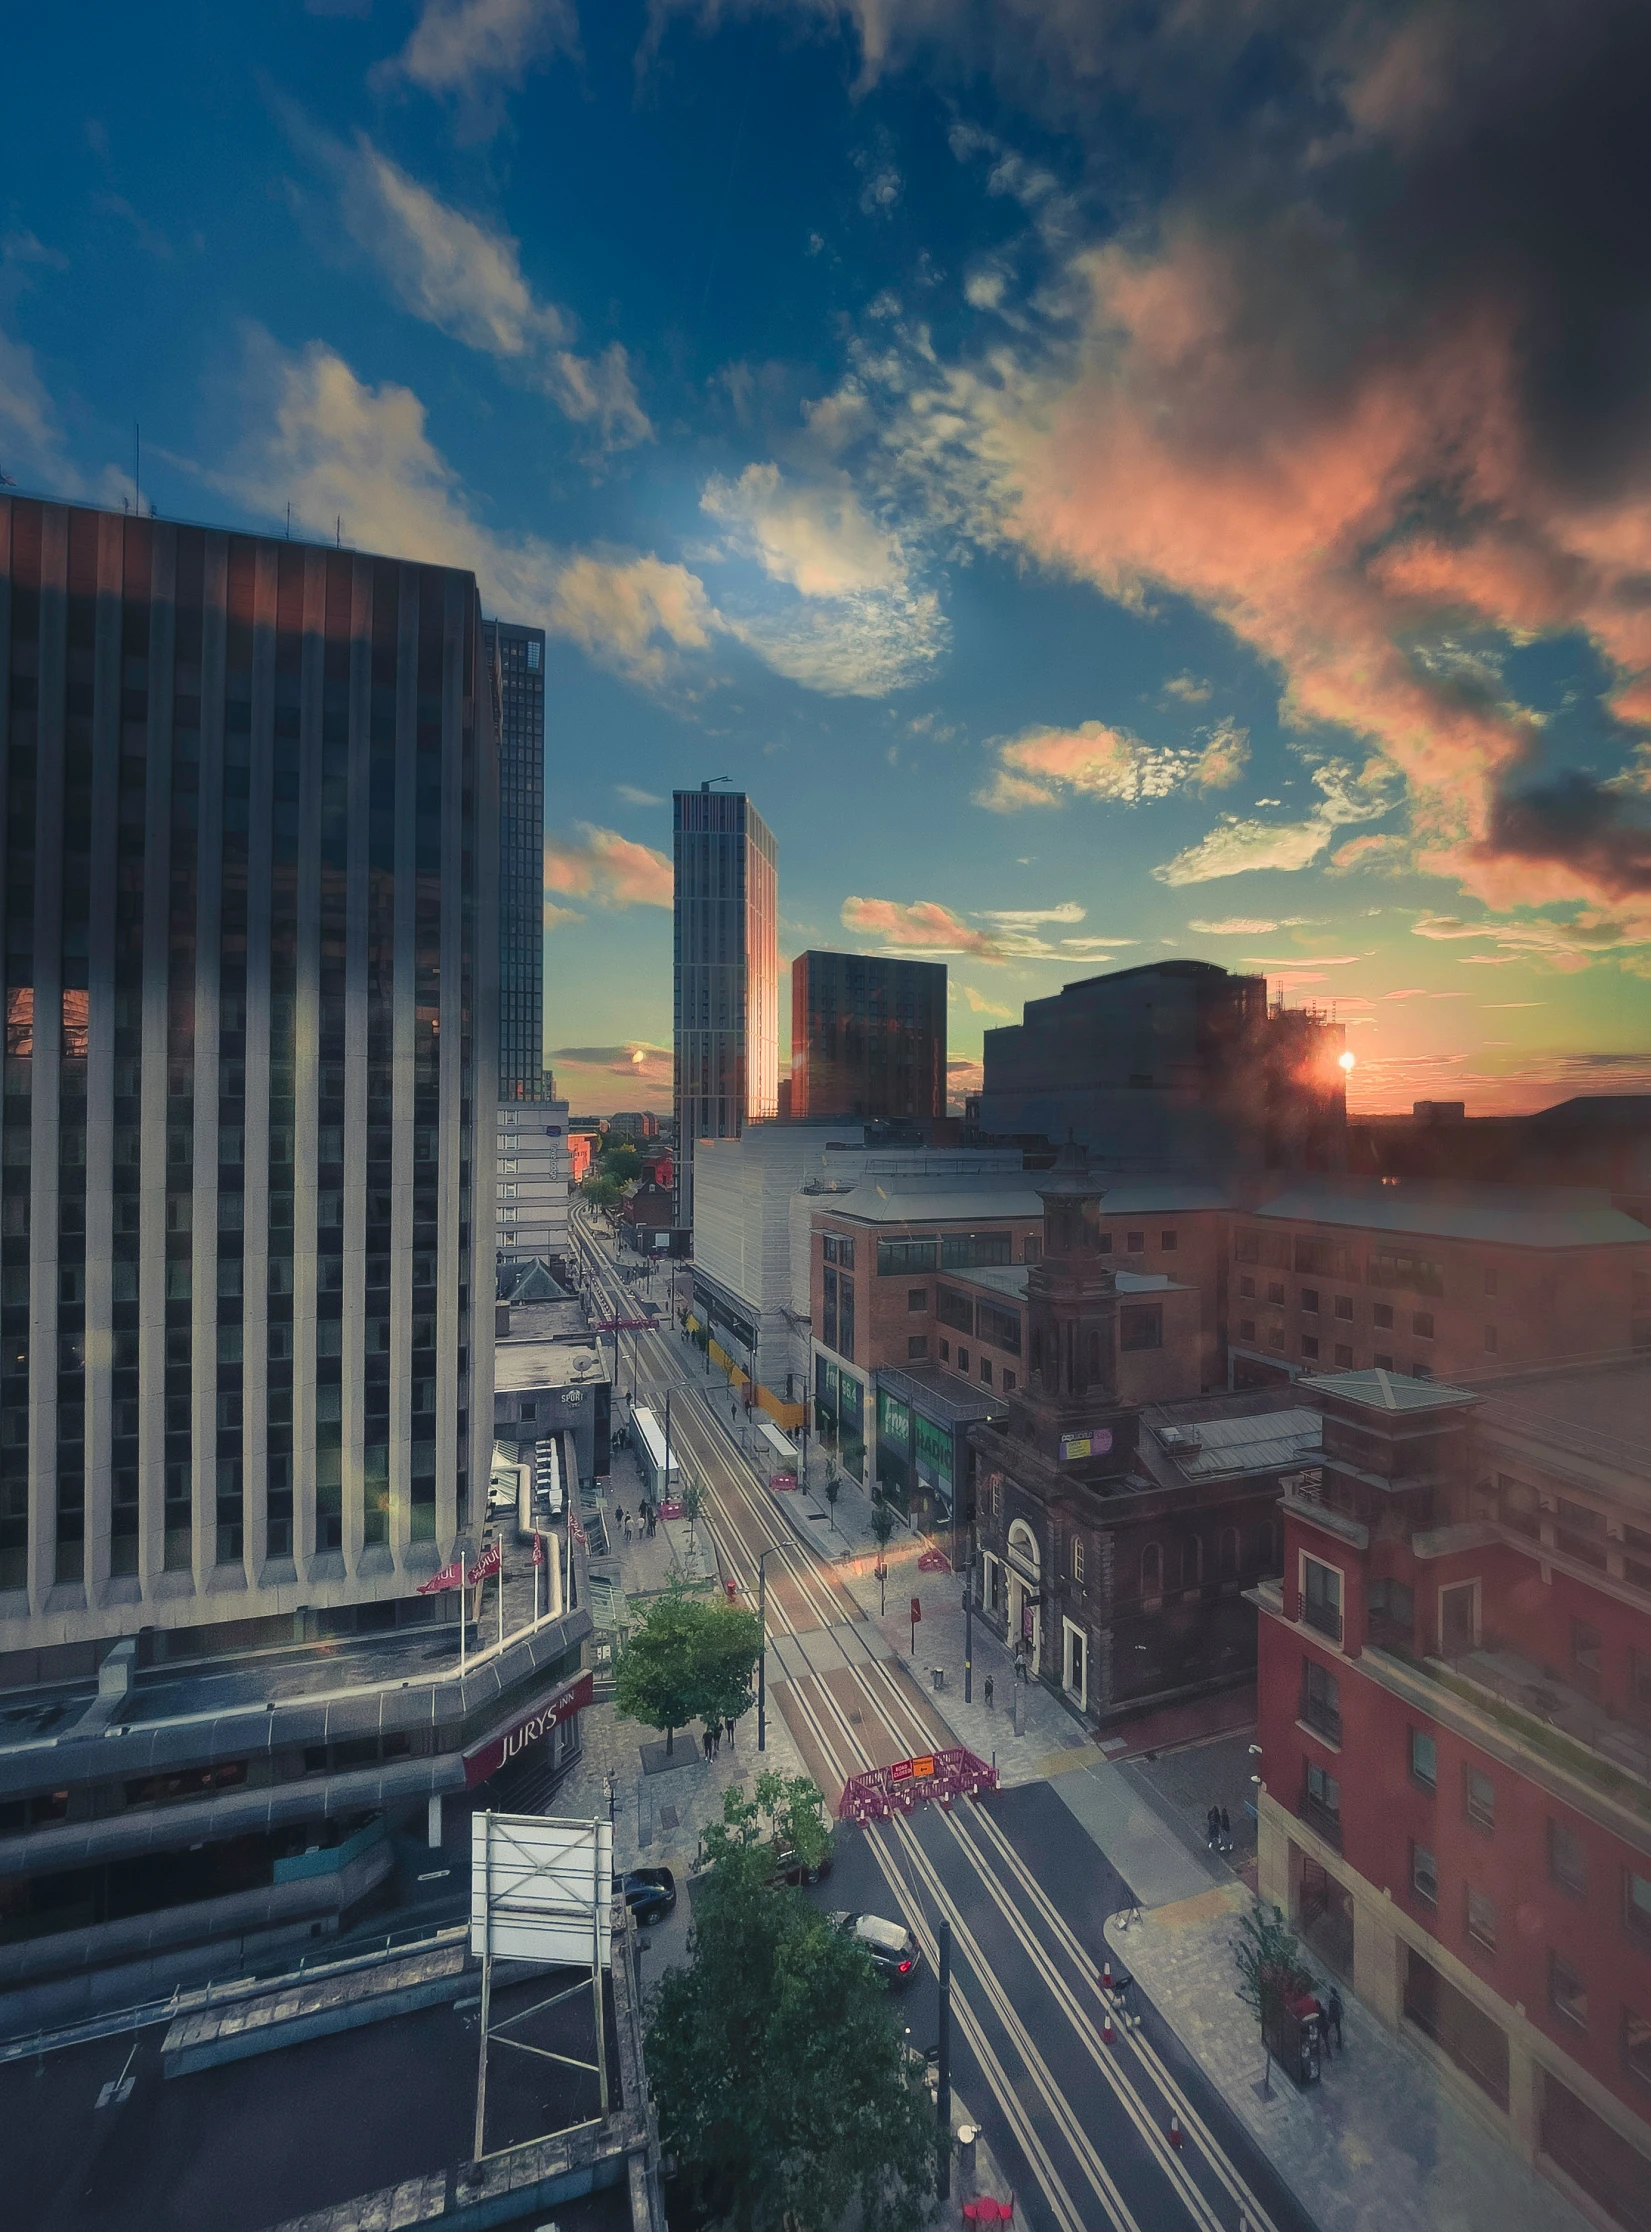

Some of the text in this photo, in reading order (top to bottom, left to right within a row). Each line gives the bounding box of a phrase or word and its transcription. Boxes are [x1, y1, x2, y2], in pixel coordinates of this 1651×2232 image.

[496, 1689, 575, 1769] JURYS INN
[895, 1763, 908, 1772] ROAD
[893, 1768, 913, 1778] CLOSED
